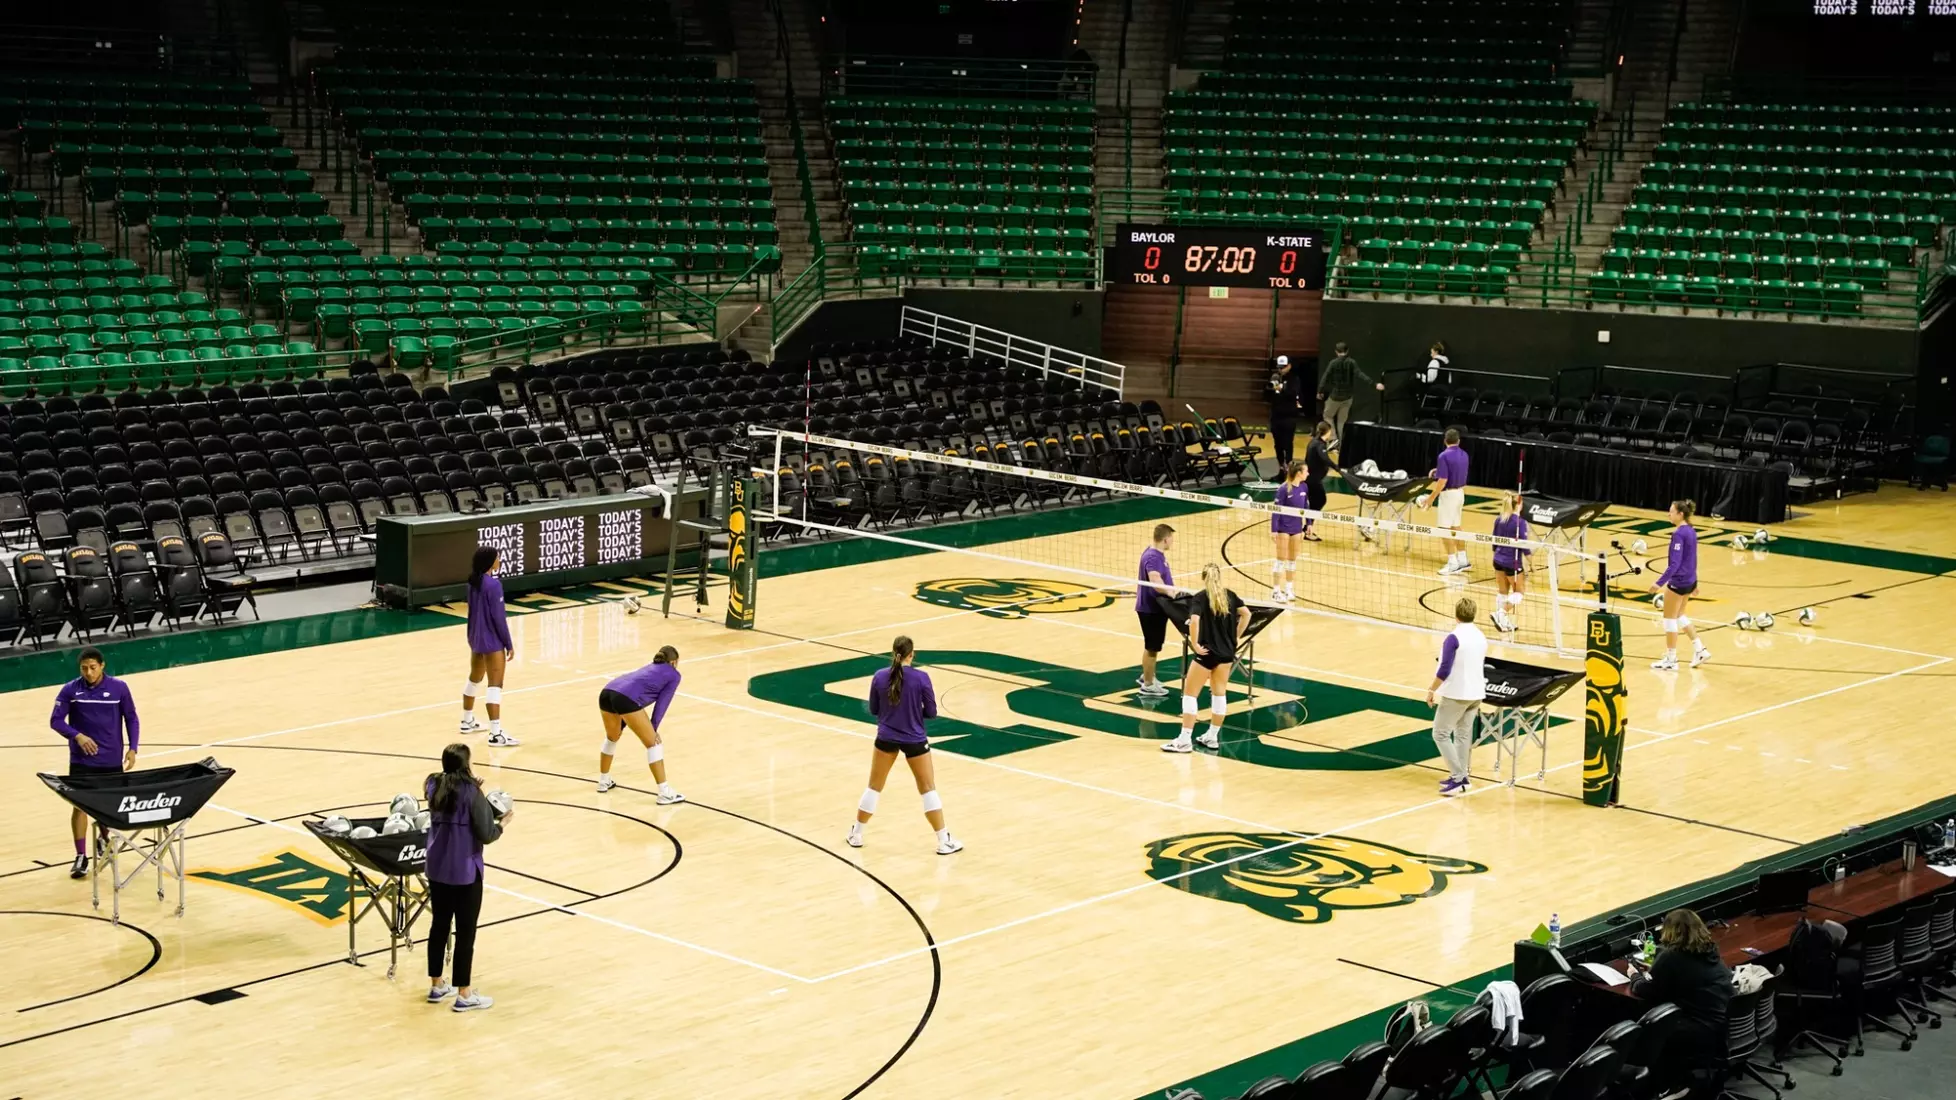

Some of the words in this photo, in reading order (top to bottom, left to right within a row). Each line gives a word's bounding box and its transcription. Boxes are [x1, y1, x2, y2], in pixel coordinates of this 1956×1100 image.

[1813, 6, 1857, 15] TODAY'S
[1870, 6, 1914, 15] TODAY'S
[1131, 232, 1175, 243] BAYLOR
[1266, 236, 1312, 247] K-STATE
[1144, 247, 1161, 270] 0
[1184, 246, 1257, 273] 87:00
[1279, 250, 1297, 274] 0
[1133, 273, 1157, 284] TOL
[1162, 274, 1170, 284] 0
[1269, 277, 1292, 288] TOL
[1298, 278, 1305, 289] 0
[734, 481, 745, 501] BU
[1357, 482, 1388, 495] Baden
[1528, 504, 1558, 518] Baden
[477, 523, 524, 541] TODAY'S
[539, 516, 584, 532] TODAY'S
[598, 509, 642, 525] TODAY'S
[539, 528, 584, 545] TODAY'S
[598, 521, 642, 537] TODAY'S
[538, 540, 584, 557] TODAY'S
[597, 533, 642, 549] TODAY'S
[492, 560, 524, 575] DAY'S
[538, 552, 584, 569] TODAY'S
[597, 545, 642, 560] TODAY'S
[1590, 621, 1611, 646] BU
[1484, 681, 1518, 696] aden
[117, 792, 182, 813] Baden
